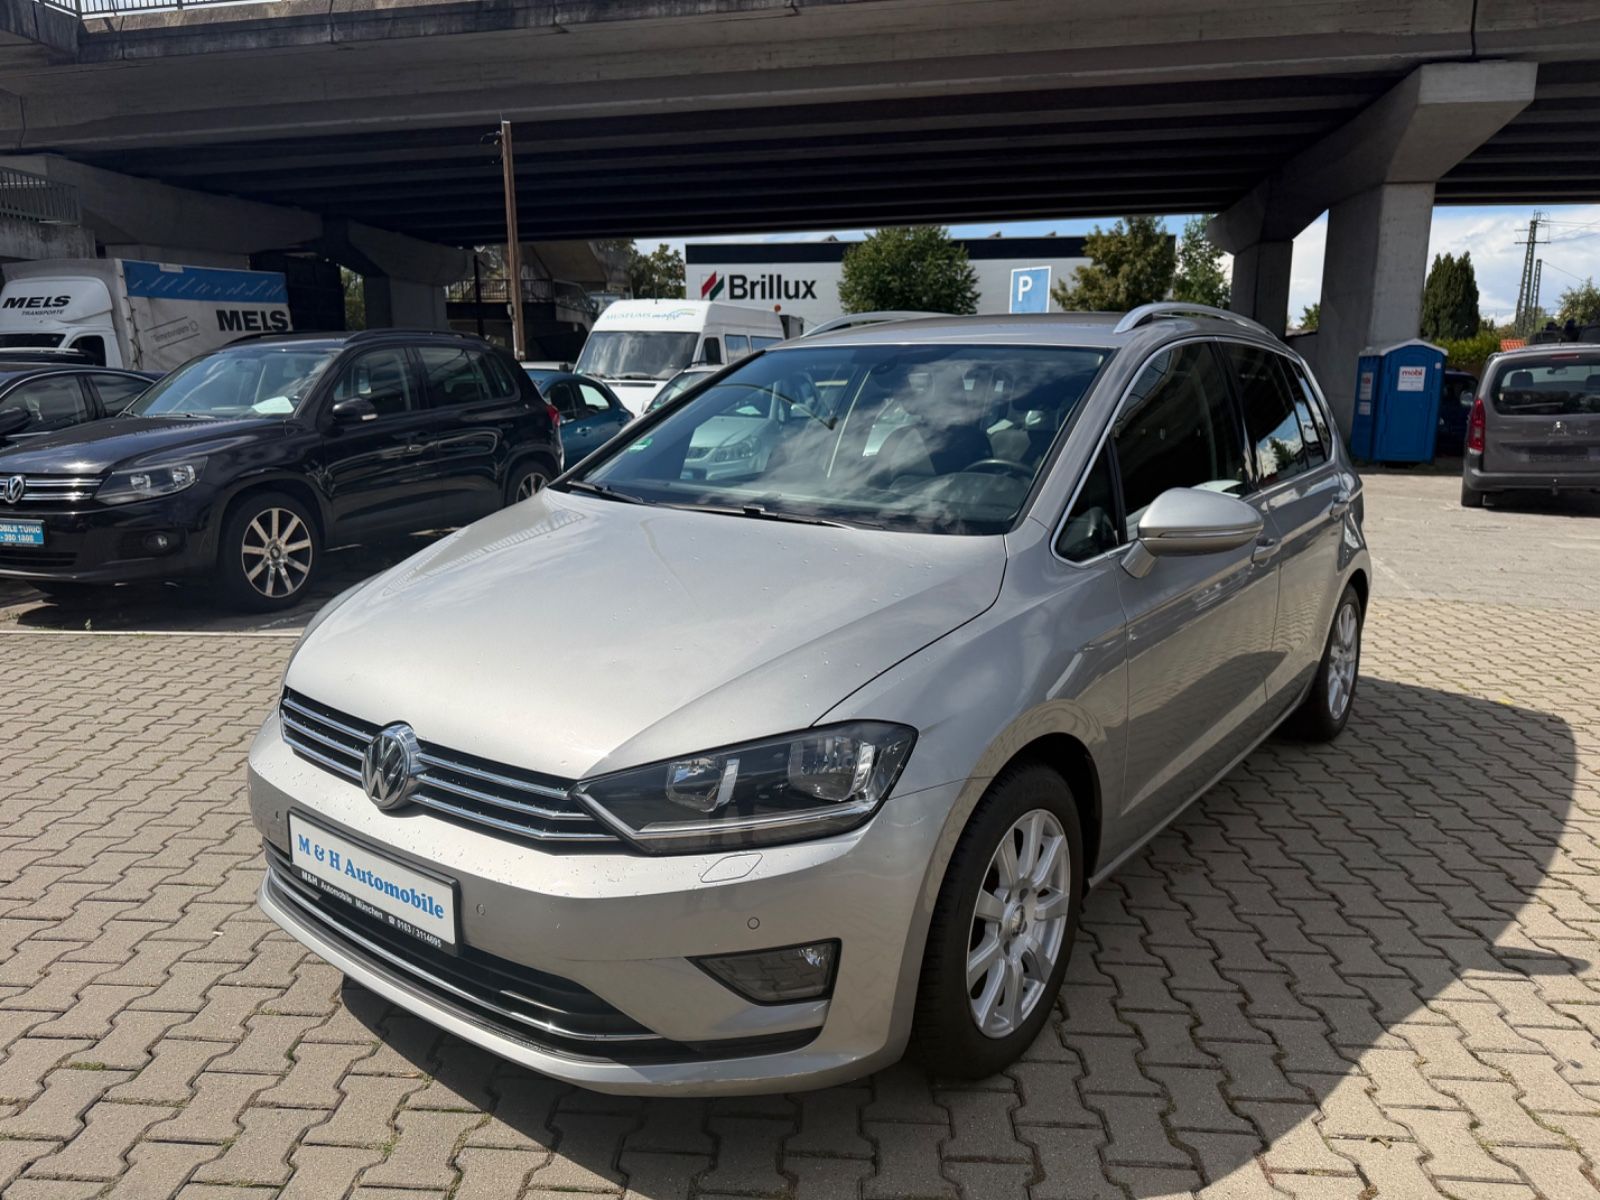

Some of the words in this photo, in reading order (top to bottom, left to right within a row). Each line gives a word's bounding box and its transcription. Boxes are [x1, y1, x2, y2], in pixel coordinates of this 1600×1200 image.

[728, 274, 817, 300] Brillux
[1017, 275, 1033, 302] P
[2, 295, 71, 309] MELS
[215, 309, 289, 332] MELS
[298, 834, 311, 855] M
[314, 844, 325, 862] &
[329, 849, 341, 871] H
[344, 858, 445, 919] Automobile
[320, 880, 353, 905] Automobile
[355, 898, 383, 920] München
